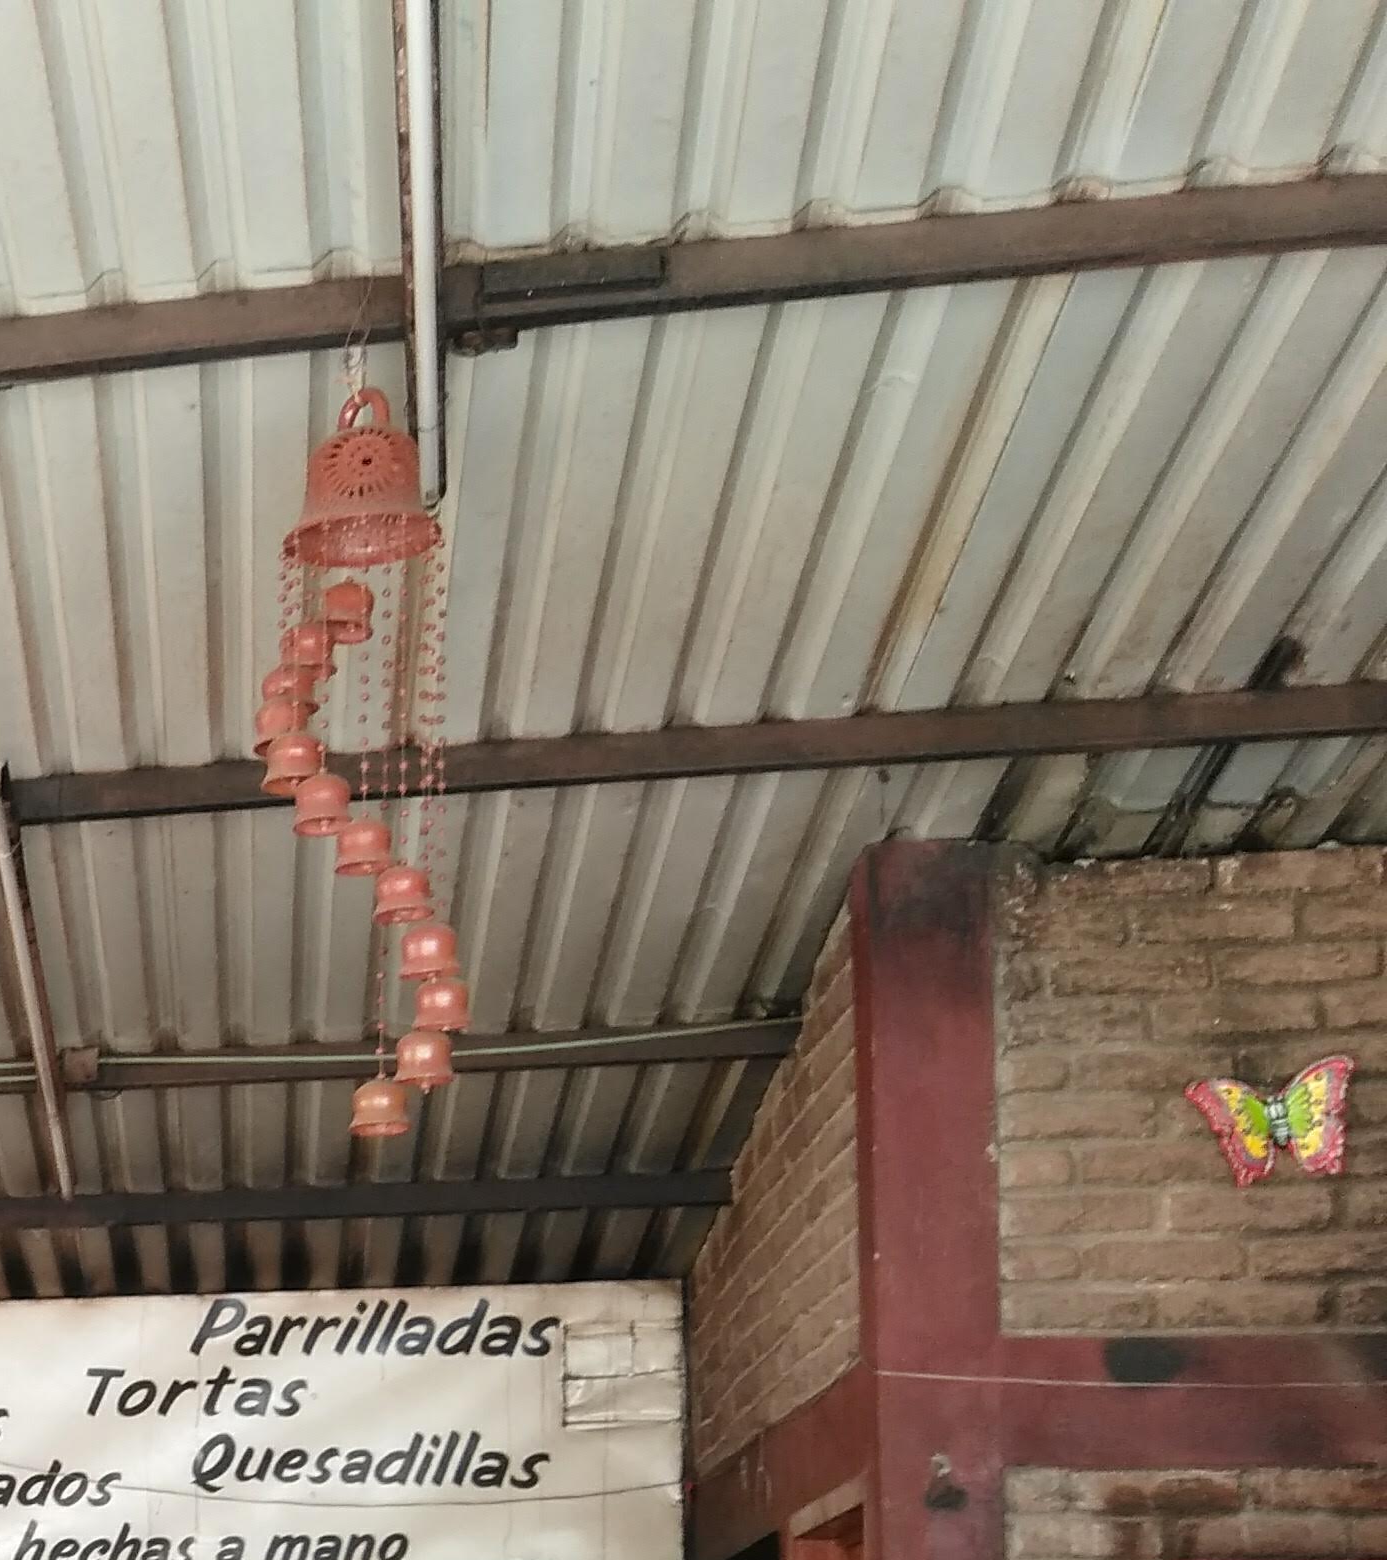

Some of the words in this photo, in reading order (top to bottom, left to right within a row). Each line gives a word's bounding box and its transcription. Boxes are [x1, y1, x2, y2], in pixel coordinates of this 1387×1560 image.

[190, 1298, 564, 1358] Parrilladas
[85, 1365, 310, 1418] Tortas
[191, 1430, 551, 1494] Quesadillas
